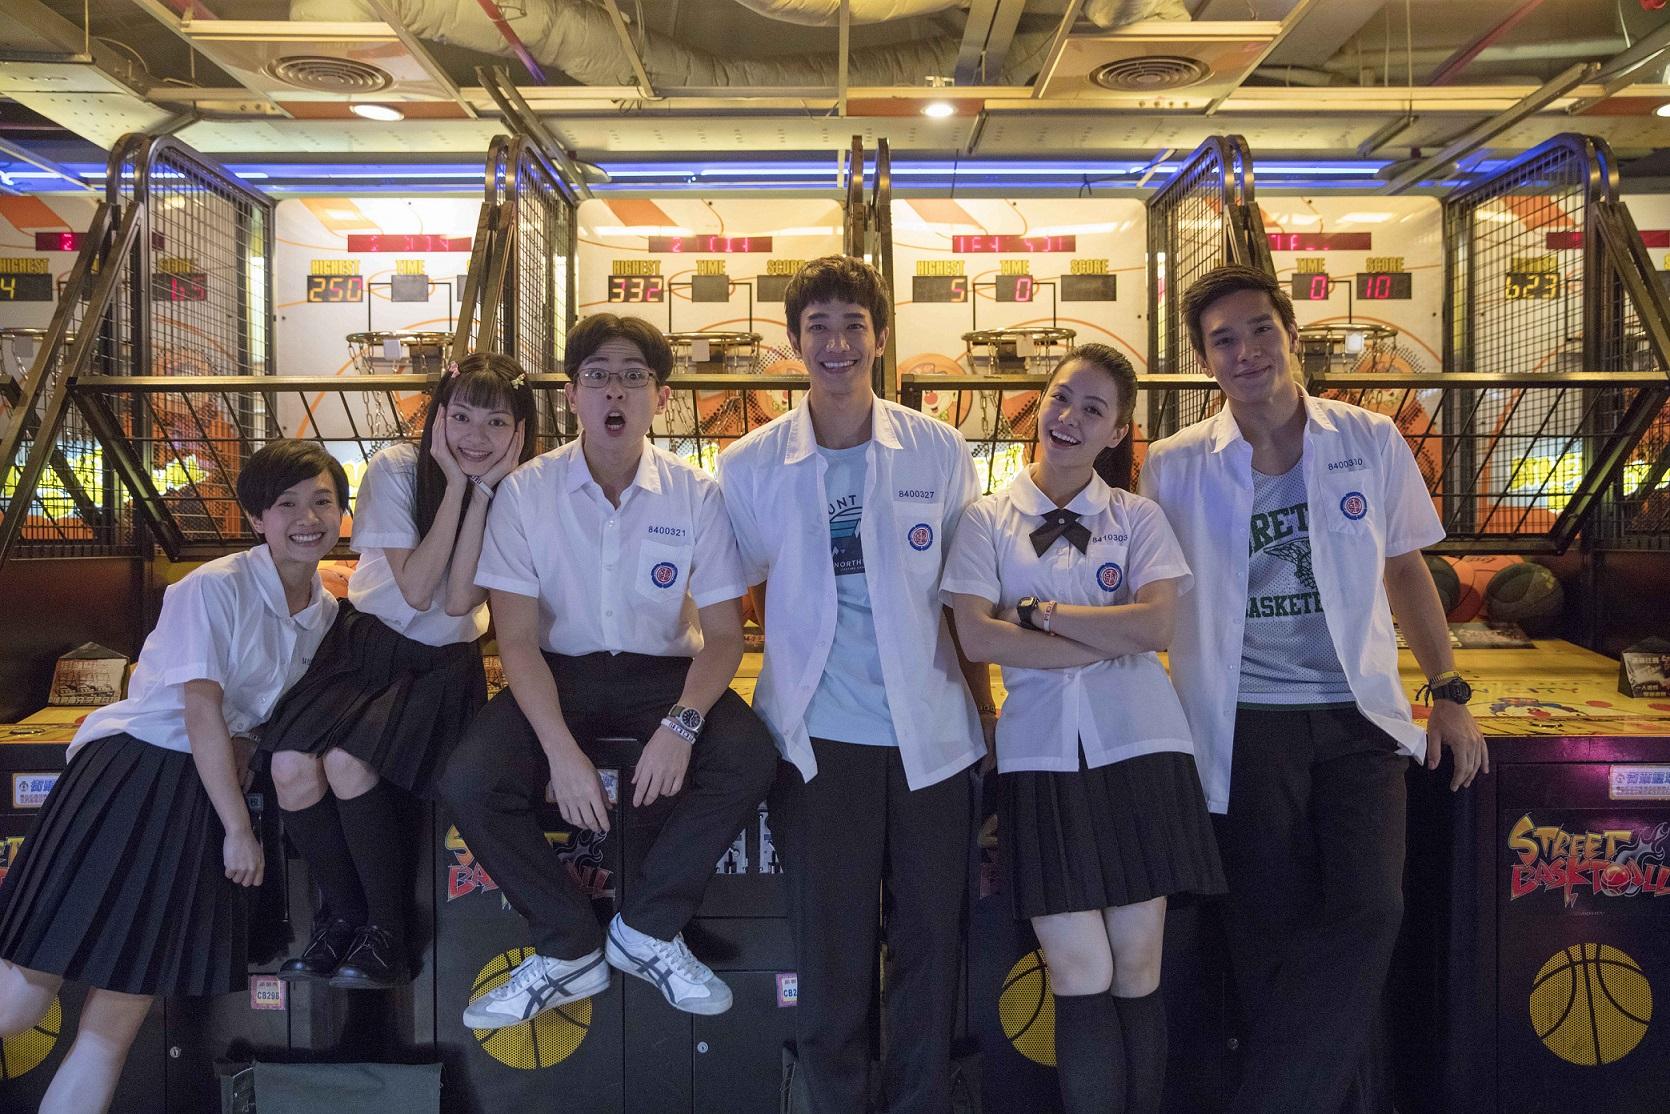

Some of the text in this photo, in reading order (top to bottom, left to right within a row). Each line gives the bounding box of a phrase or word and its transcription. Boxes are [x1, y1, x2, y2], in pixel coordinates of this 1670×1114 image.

[311, 259, 360, 275] HIGHEST
[396, 259, 425, 275] TIME
[612, 259, 662, 275] HIGHEST
[696, 259, 726, 275] TIME
[916, 260, 965, 276] HIGHEST
[1000, 260, 1029, 275] TIME
[1070, 259, 1109, 275] SCORE
[1296, 257, 1326, 272] TIME
[1365, 256, 1405, 272] SCORE
[309, 278, 362, 302] 250
[611, 278, 662, 302] 332
[950, 278, 966, 302] 5
[1015, 278, 1031, 302] 0
[1310, 275, 1327, 300] 0
[1366, 275, 1391, 299] 10
[898, 490, 935, 500] 8400327
[648, 525, 687, 537] 8400321
[1246, 591, 1324, 618] ASKET
[1508, 814, 1633, 866] STREET
